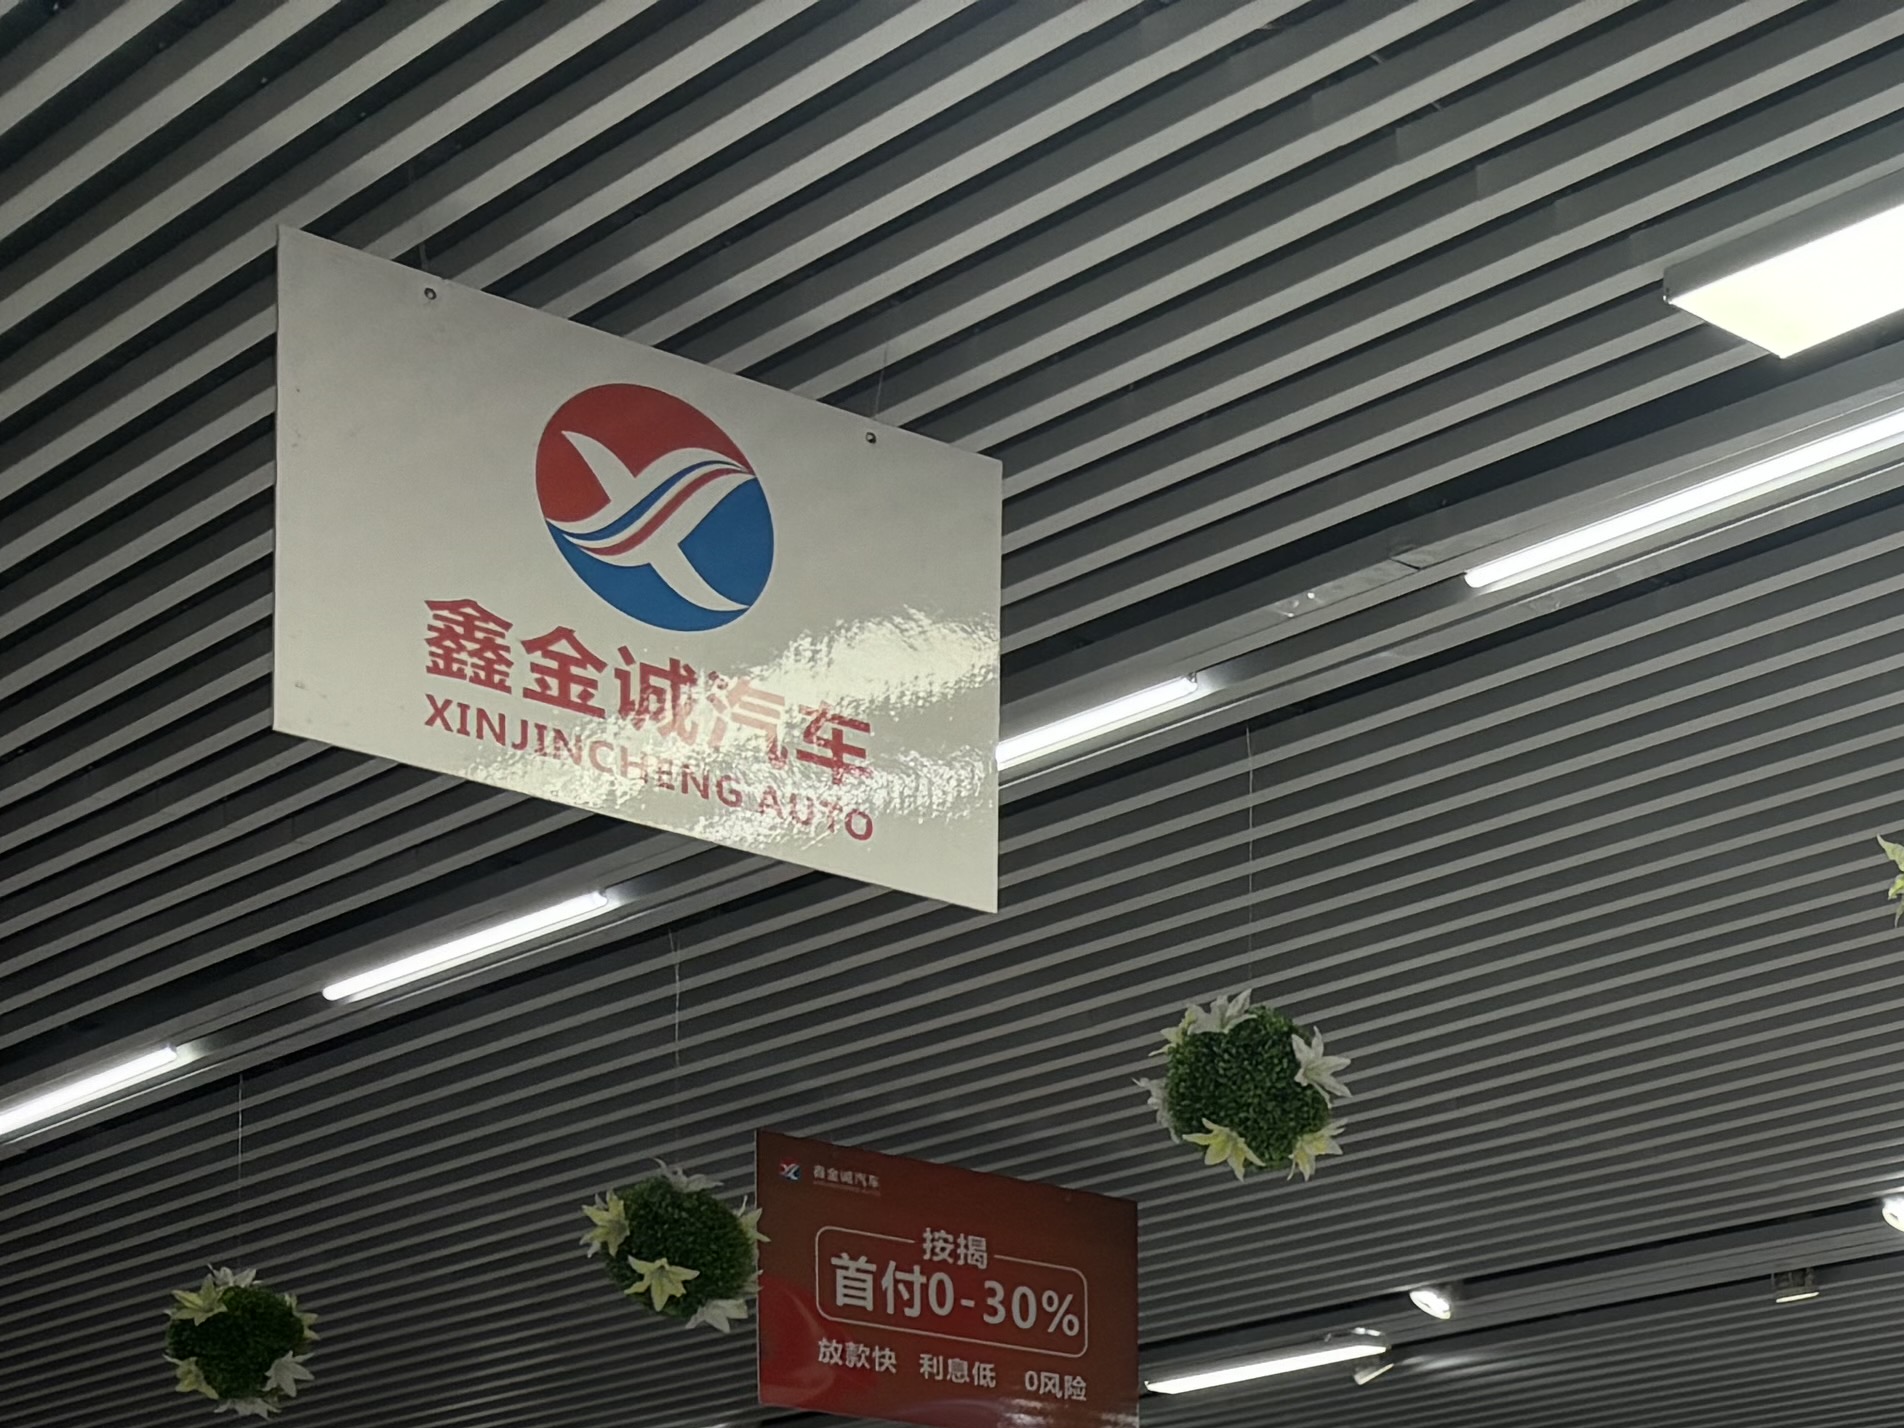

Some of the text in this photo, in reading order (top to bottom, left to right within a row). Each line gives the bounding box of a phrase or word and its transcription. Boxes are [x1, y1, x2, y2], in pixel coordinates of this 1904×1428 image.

[424, 598, 874, 784] 鑫金诚汽车
[424, 694, 874, 841] XINJINCHENG AUTO
[922, 1227, 988, 1268] 按揭
[830, 1253, 1080, 1337] 首付0-30%
[818, 1337, 1087, 1400] 放款快 利息低 0风险
